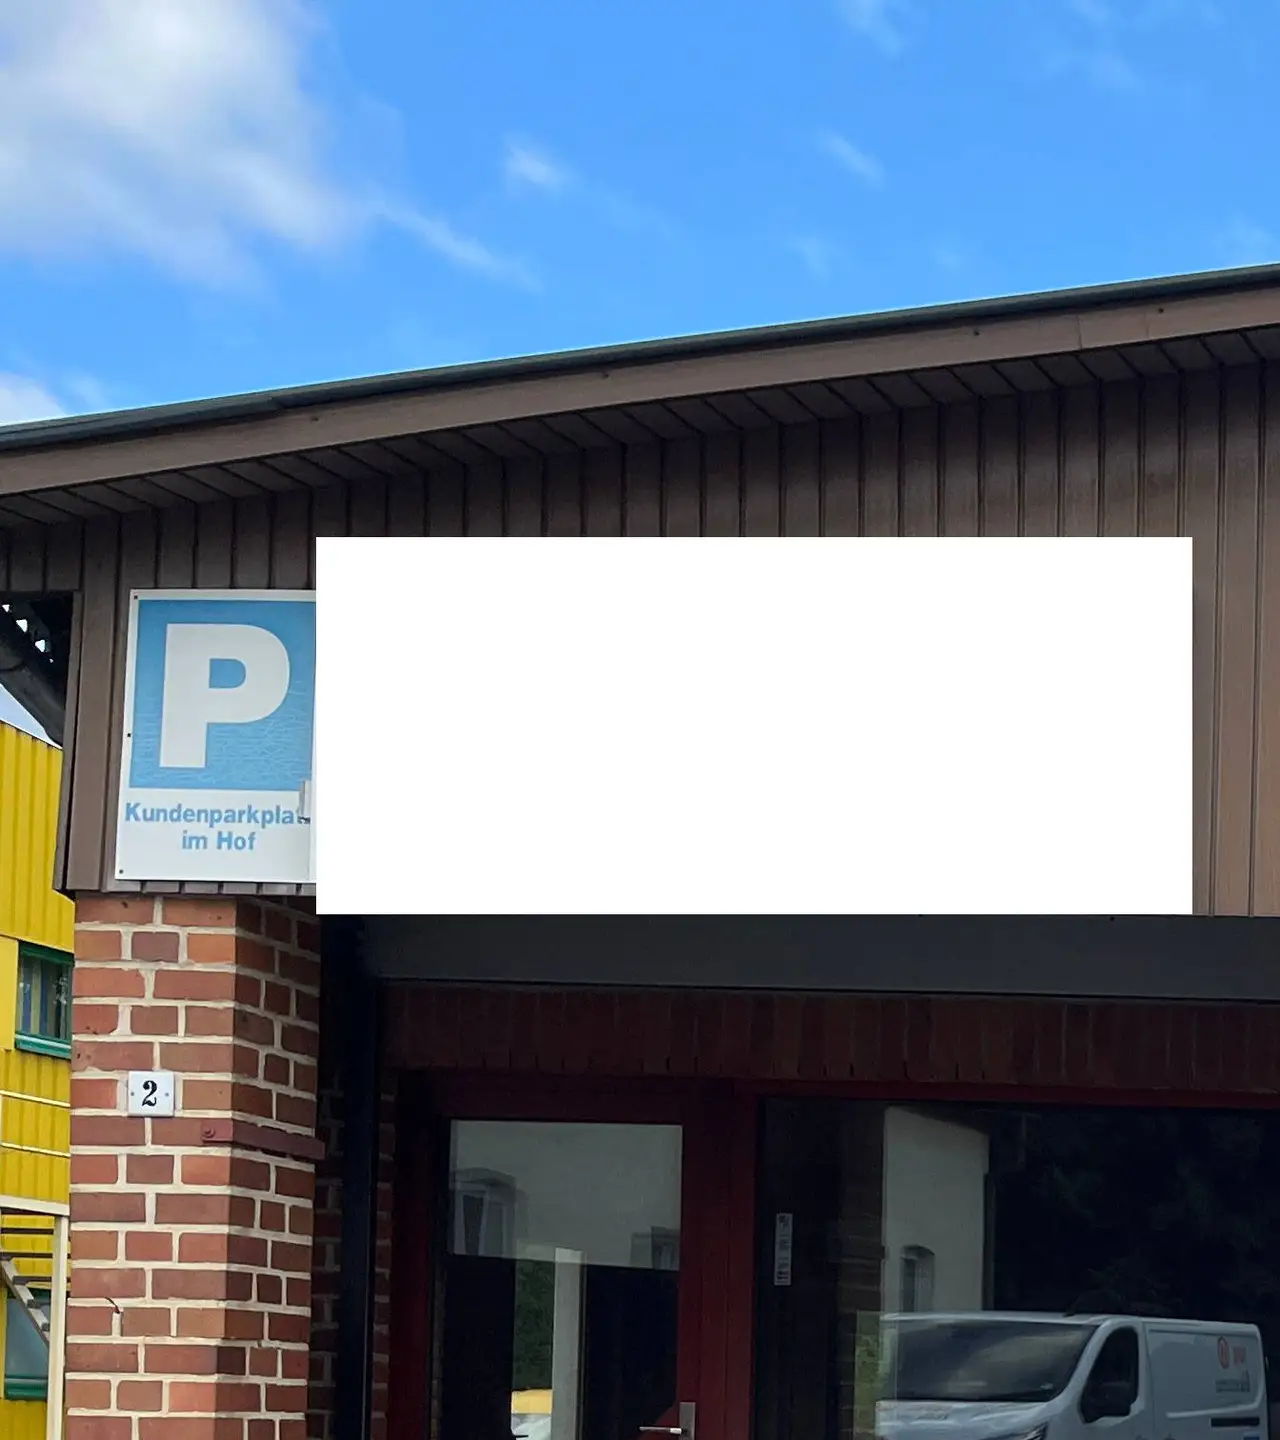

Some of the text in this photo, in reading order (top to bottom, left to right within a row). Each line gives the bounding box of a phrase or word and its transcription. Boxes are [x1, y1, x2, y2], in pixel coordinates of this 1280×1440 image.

[159, 623, 291, 768] P
[125, 802, 310, 829] Kundenparkpla
[182, 830, 257, 851] im Hof
[142, 1080, 157, 1107] 2
